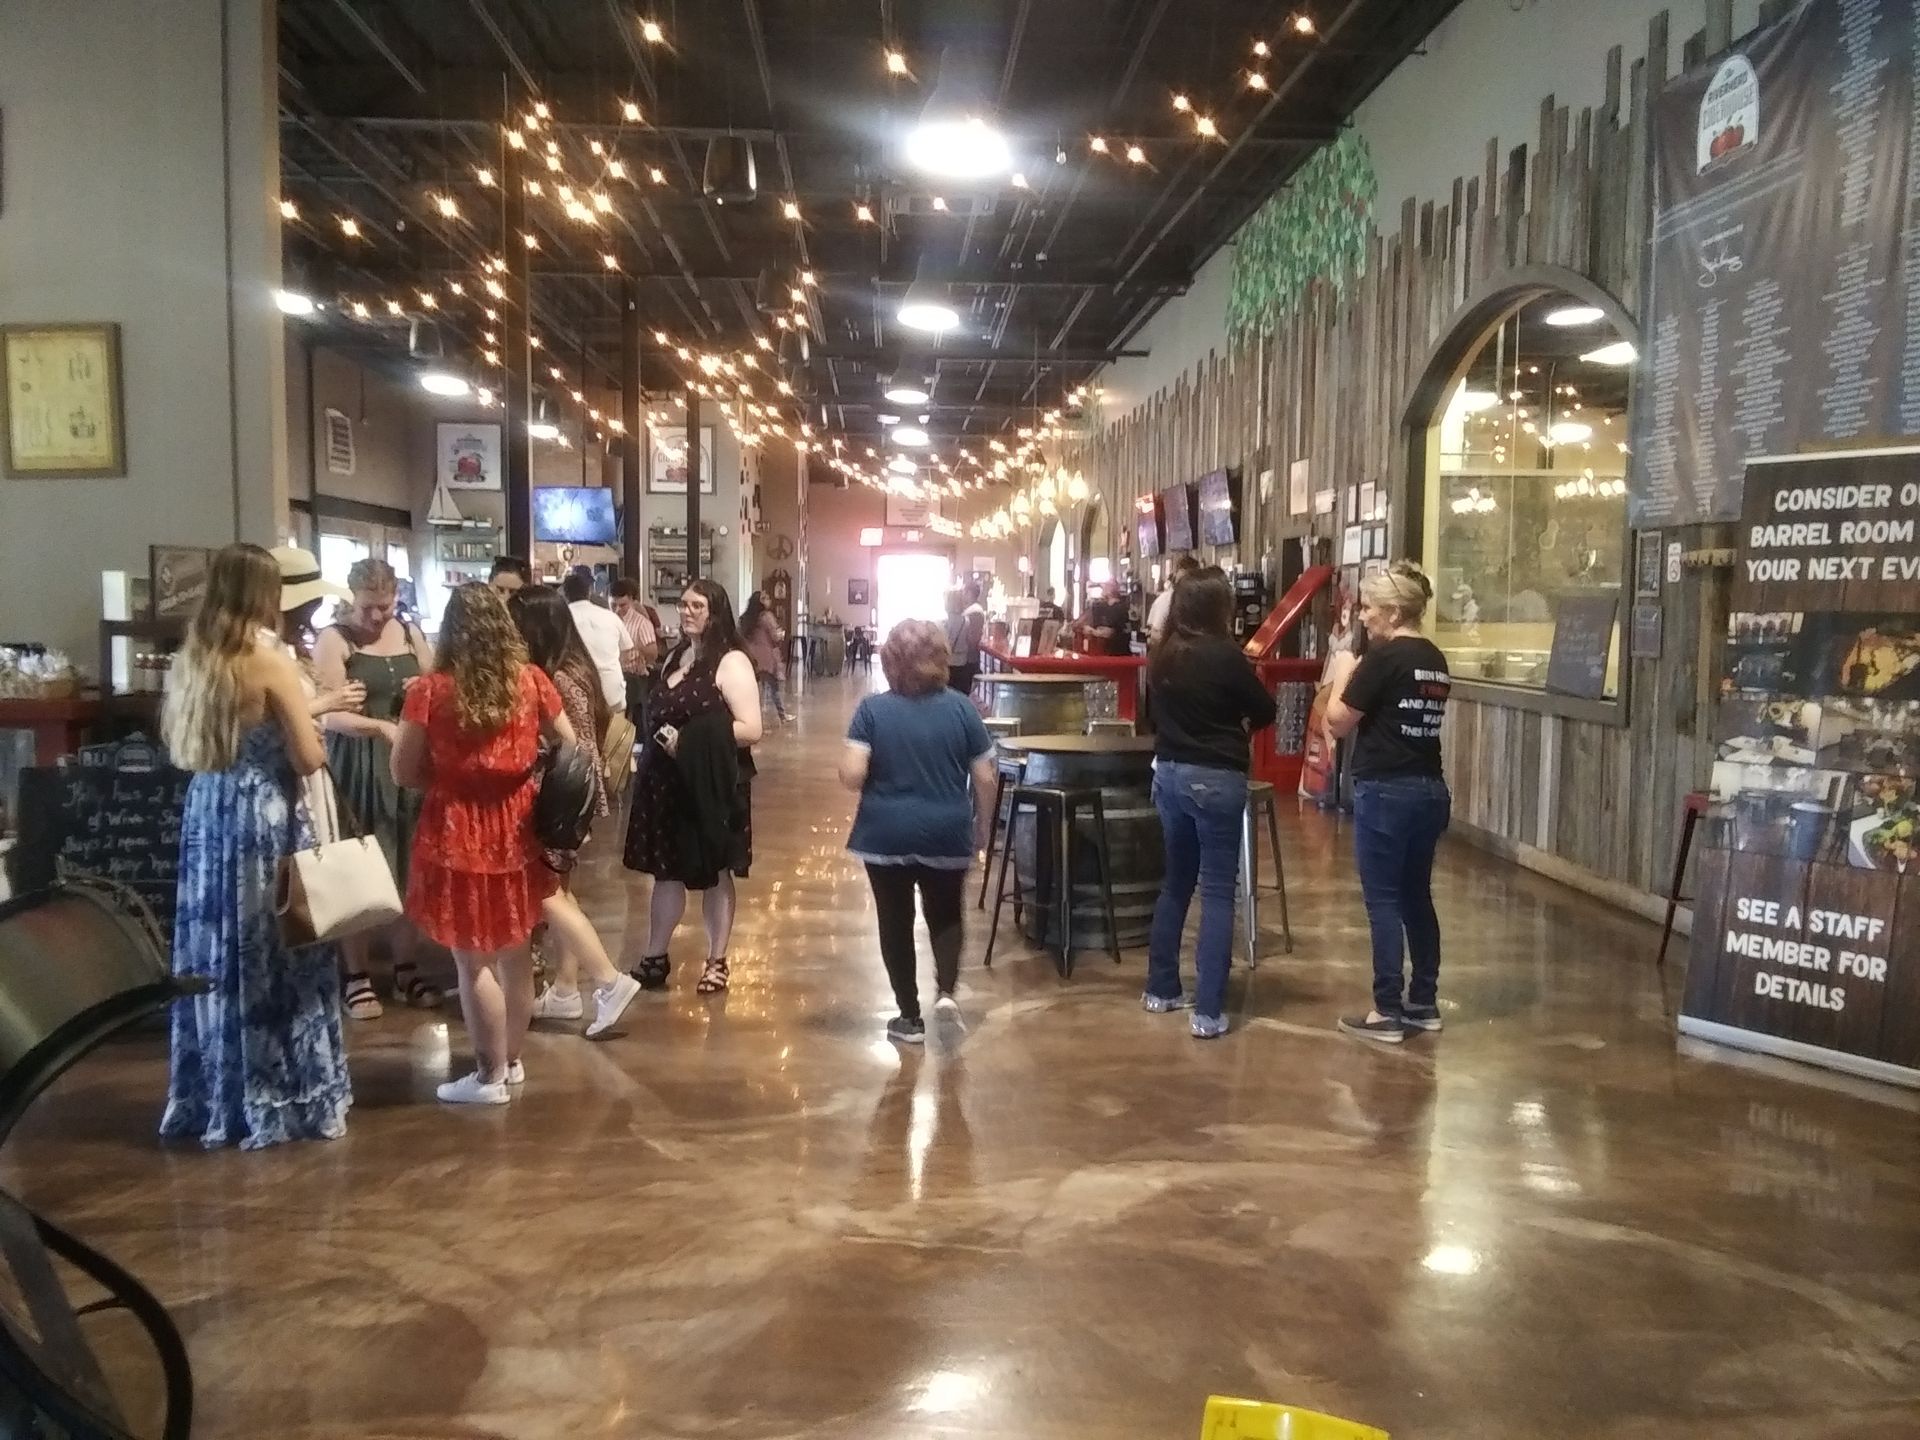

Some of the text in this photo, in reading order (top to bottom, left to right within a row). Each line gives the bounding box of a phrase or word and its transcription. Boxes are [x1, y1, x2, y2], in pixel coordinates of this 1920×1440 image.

[1774, 482, 1920, 512] CONSIDER O
[1750, 520, 1914, 548] BARREL ROOM
[1745, 556, 1920, 582] YOUR NEXT EV
[1414, 669, 1434, 681] BEEN
[1398, 698, 1424, 710] AND
[1400, 724, 1423, 738] THIS
[1737, 898, 1884, 942] SEE A STAFF
[1726, 931, 1887, 982] MEMBER FOR
[1755, 972, 1846, 1011] DETAILS
